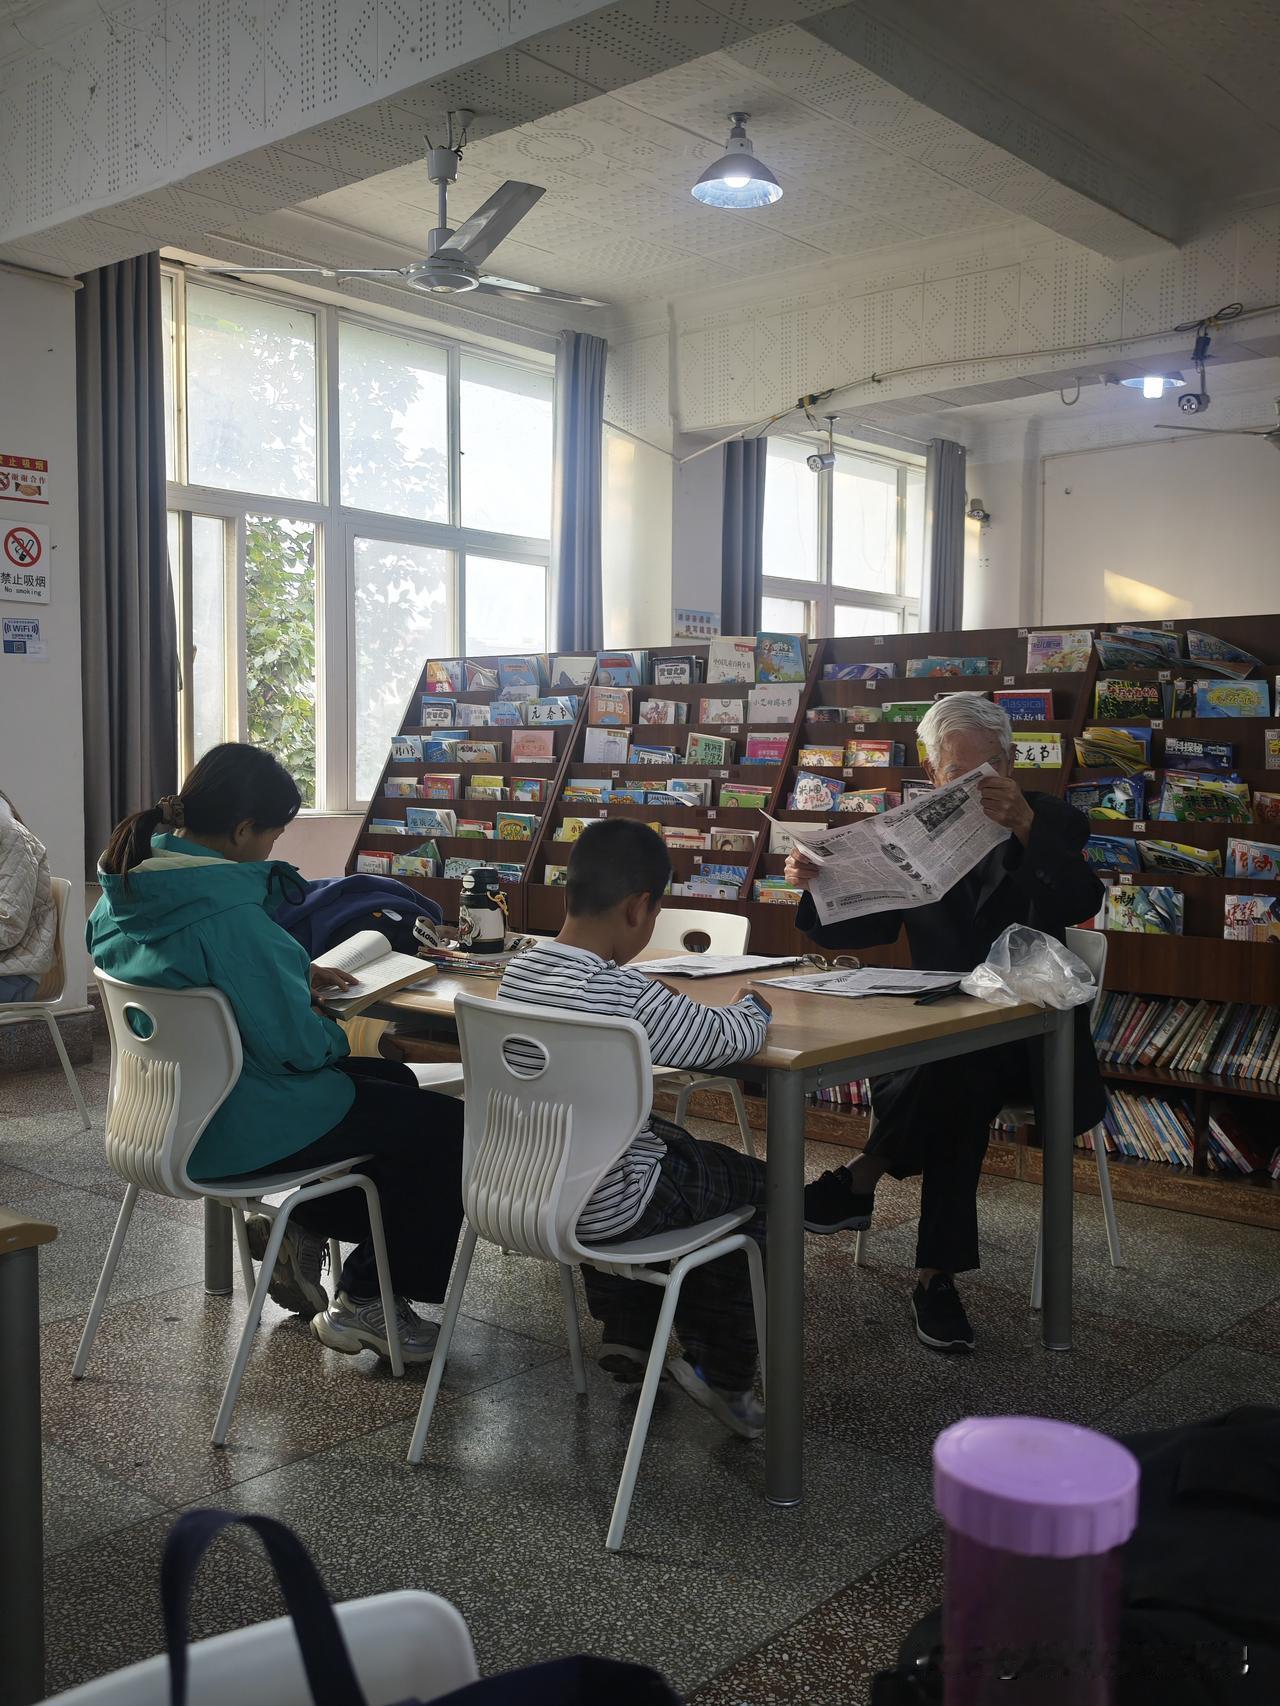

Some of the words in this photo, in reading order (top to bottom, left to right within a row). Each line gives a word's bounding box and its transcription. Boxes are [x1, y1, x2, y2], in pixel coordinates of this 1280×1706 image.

[0, 572, 46, 588] 禁止吸烟
[16, 588, 42, 597] smoking
[12, 624, 31, 633] WiFi
